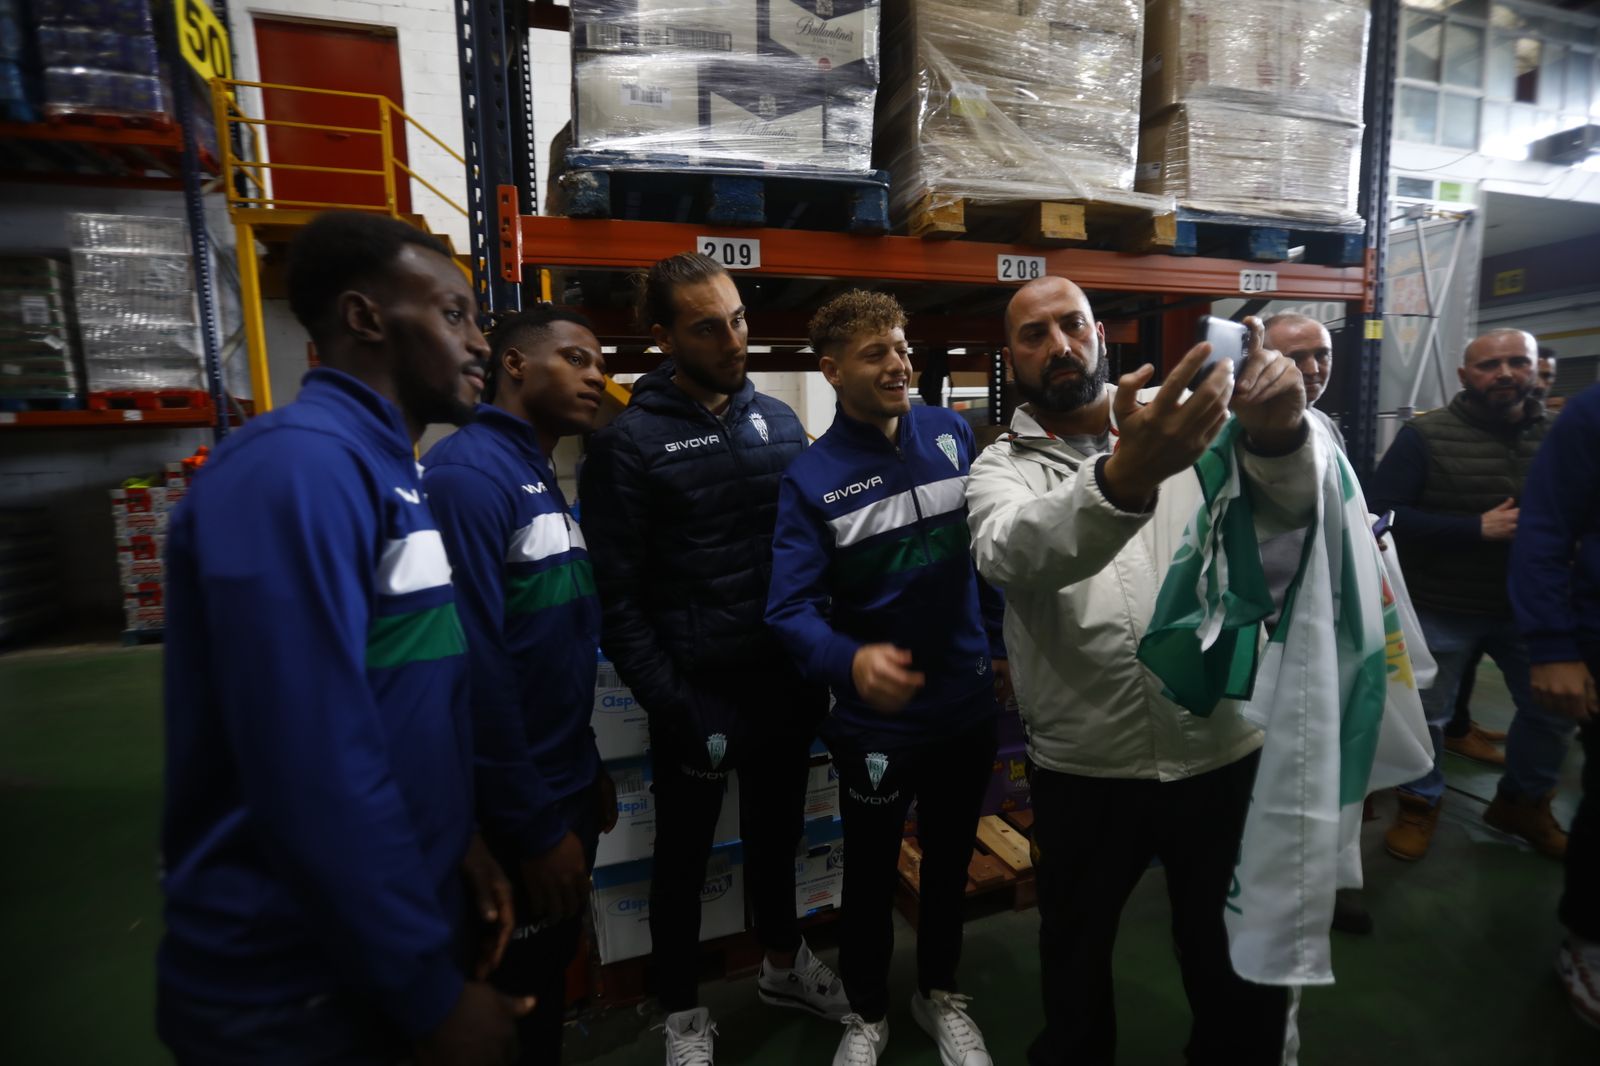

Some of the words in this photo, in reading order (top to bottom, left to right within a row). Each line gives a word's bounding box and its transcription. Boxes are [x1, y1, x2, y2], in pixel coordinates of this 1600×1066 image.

[184, 0, 227, 78] 50
[704, 241, 752, 266] 209
[1002, 258, 1040, 279] 208
[1244, 273, 1272, 291] 207
[665, 434, 720, 452] GIVOVA
[823, 475, 884, 504] GIVOVA
[602, 696, 636, 712] asp
